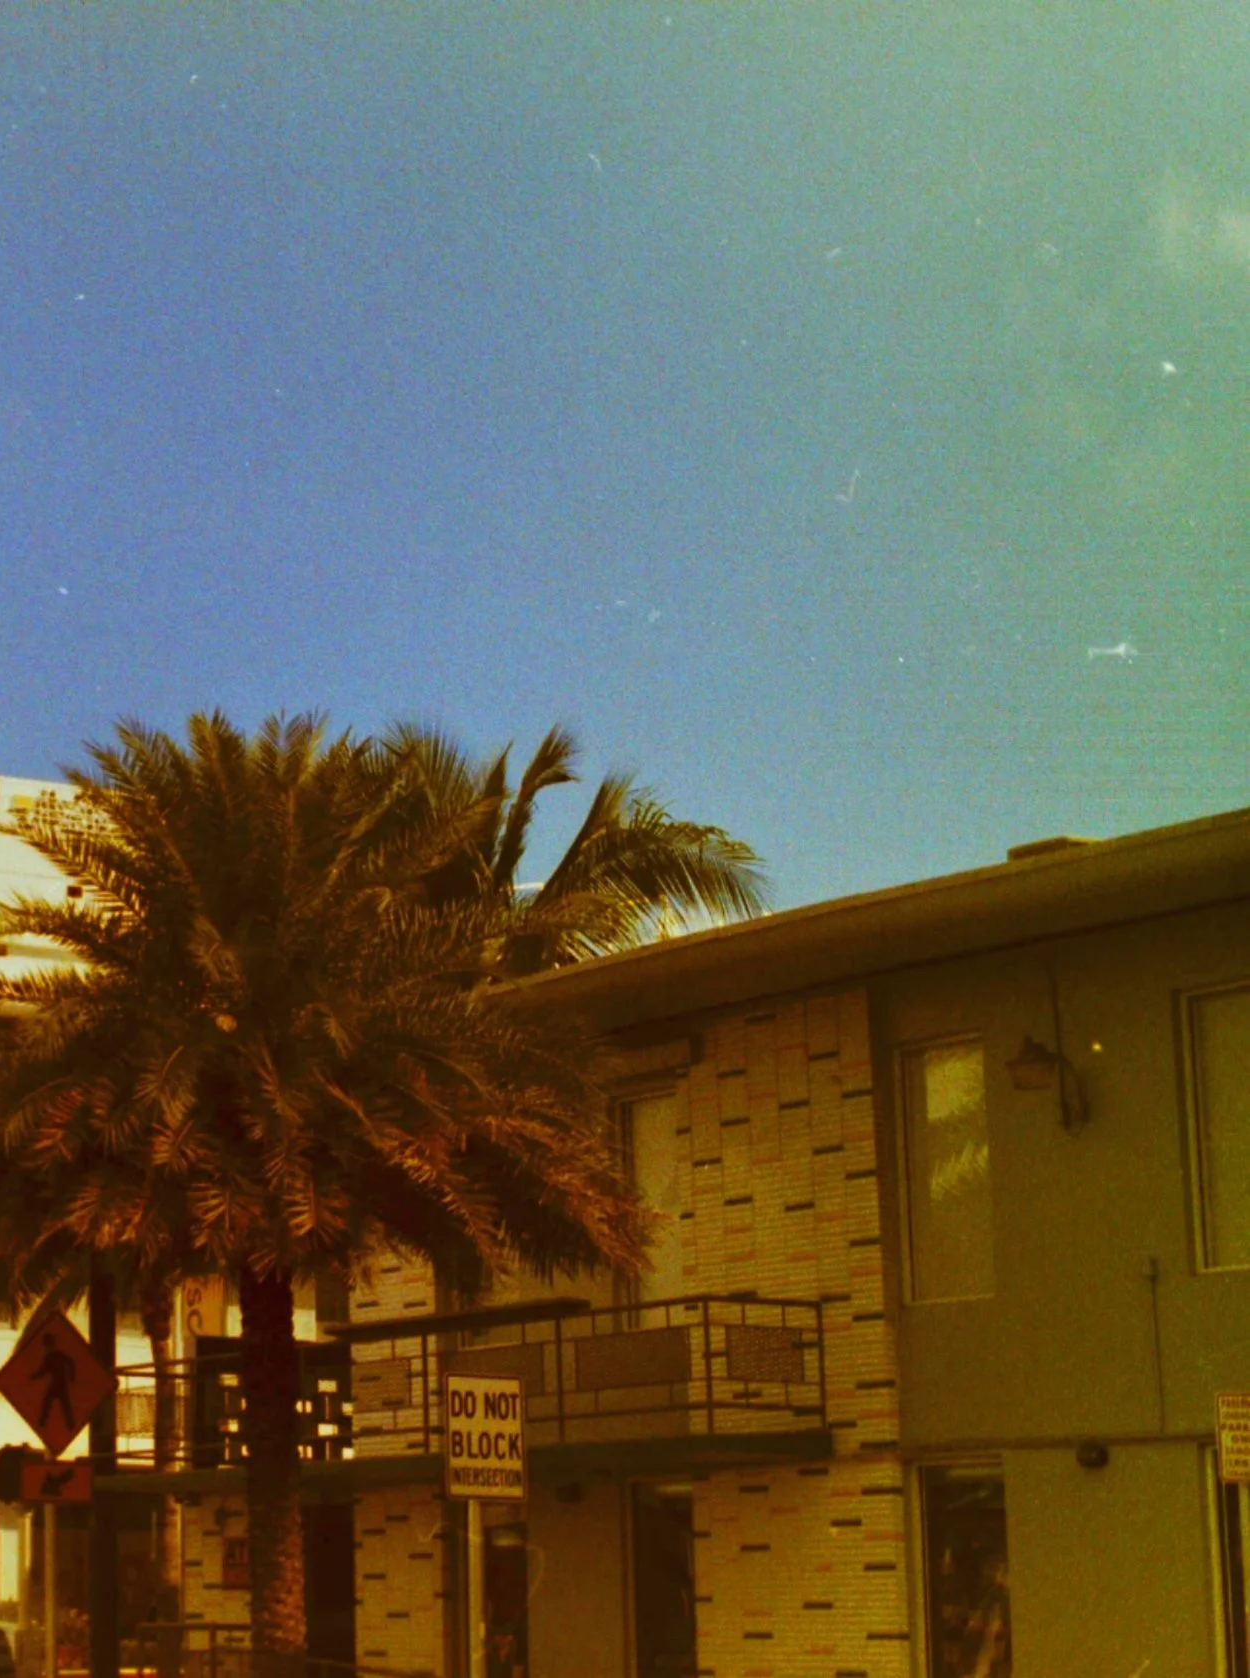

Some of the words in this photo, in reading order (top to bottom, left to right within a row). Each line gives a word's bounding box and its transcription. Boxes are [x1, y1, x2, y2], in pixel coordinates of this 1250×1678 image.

[450, 1390, 476, 1419] DO
[484, 1391, 519, 1420] NOT
[451, 1430, 521, 1460] BLOCK
[449, 1467, 523, 1488] INTERSECTION
